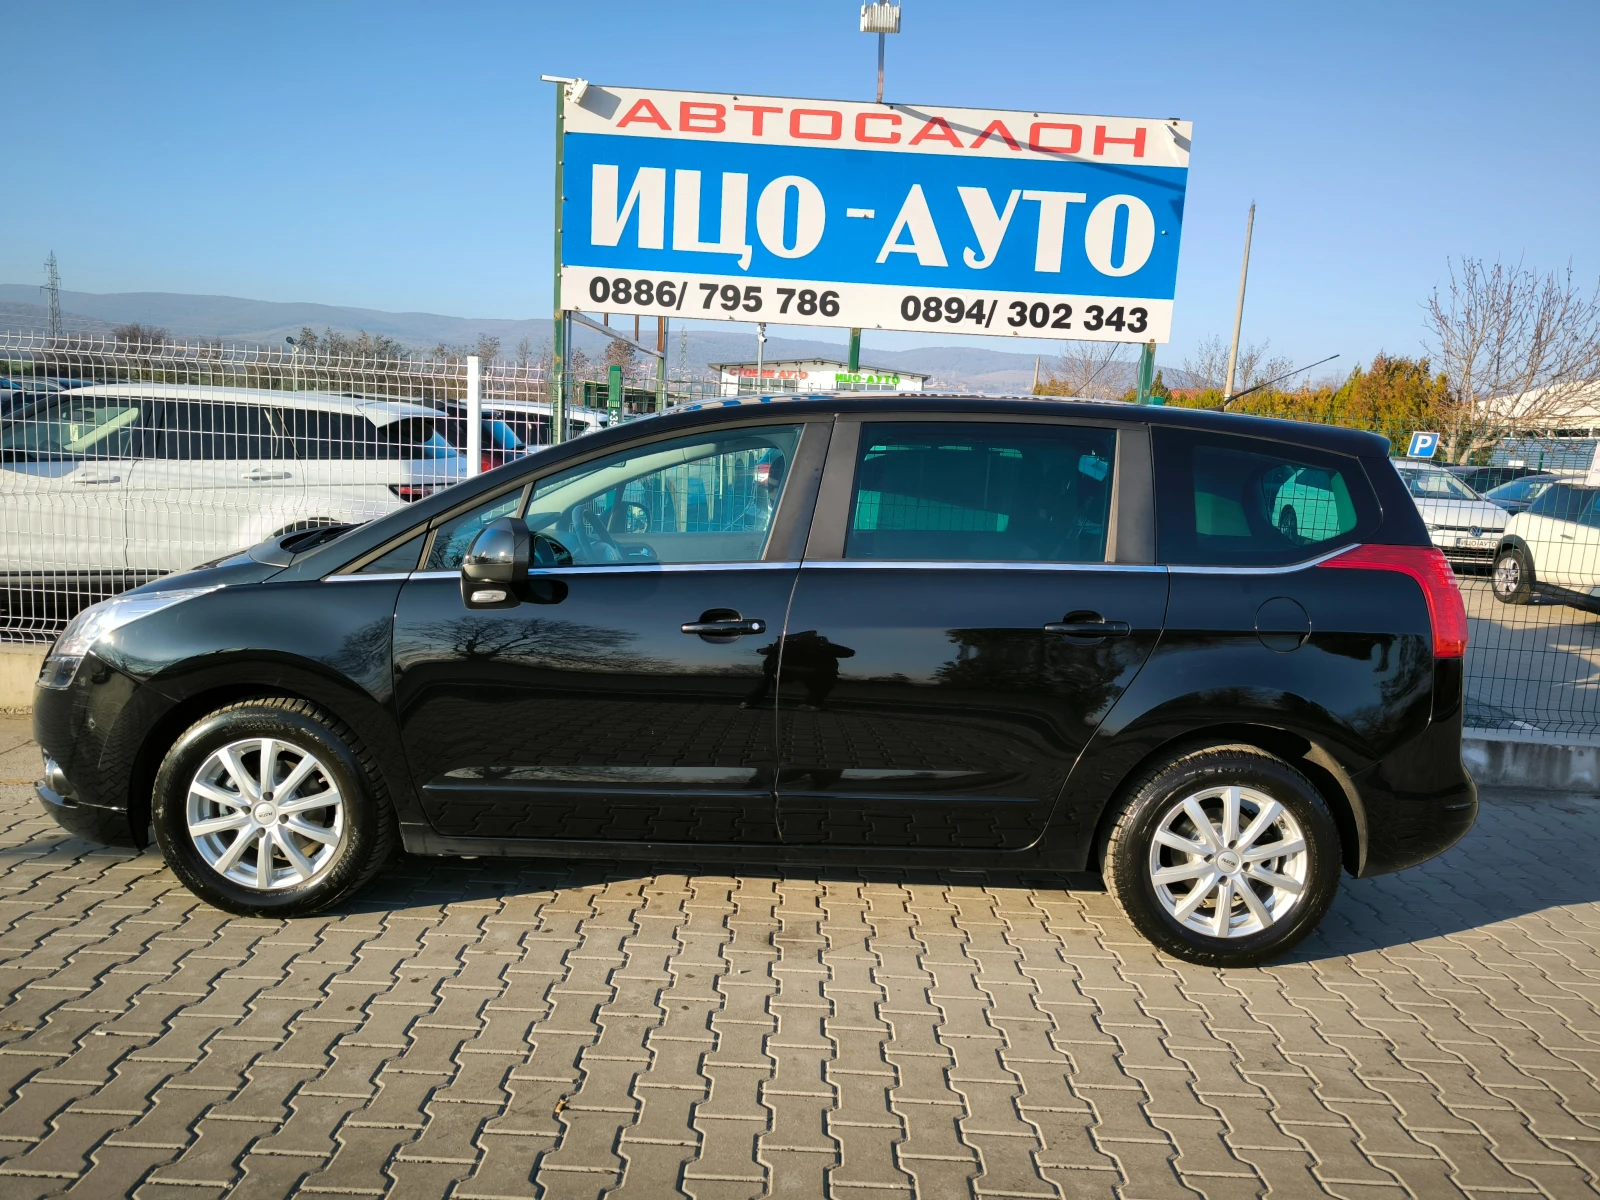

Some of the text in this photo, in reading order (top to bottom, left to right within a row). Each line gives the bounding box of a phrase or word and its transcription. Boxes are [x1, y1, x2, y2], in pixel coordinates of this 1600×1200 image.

[615, 98, 1147, 158] АВТОСАЛОН
[590, 163, 826, 271] ИЦО
[589, 276, 840, 317] 0886/ 795 786
[900, 295, 1149, 333] 0894/ 302 343
[778, 369, 809, 380] АУТО
[835, 373, 901, 385] ИЦО-АУТО
[1414, 435, 1432, 454] P
